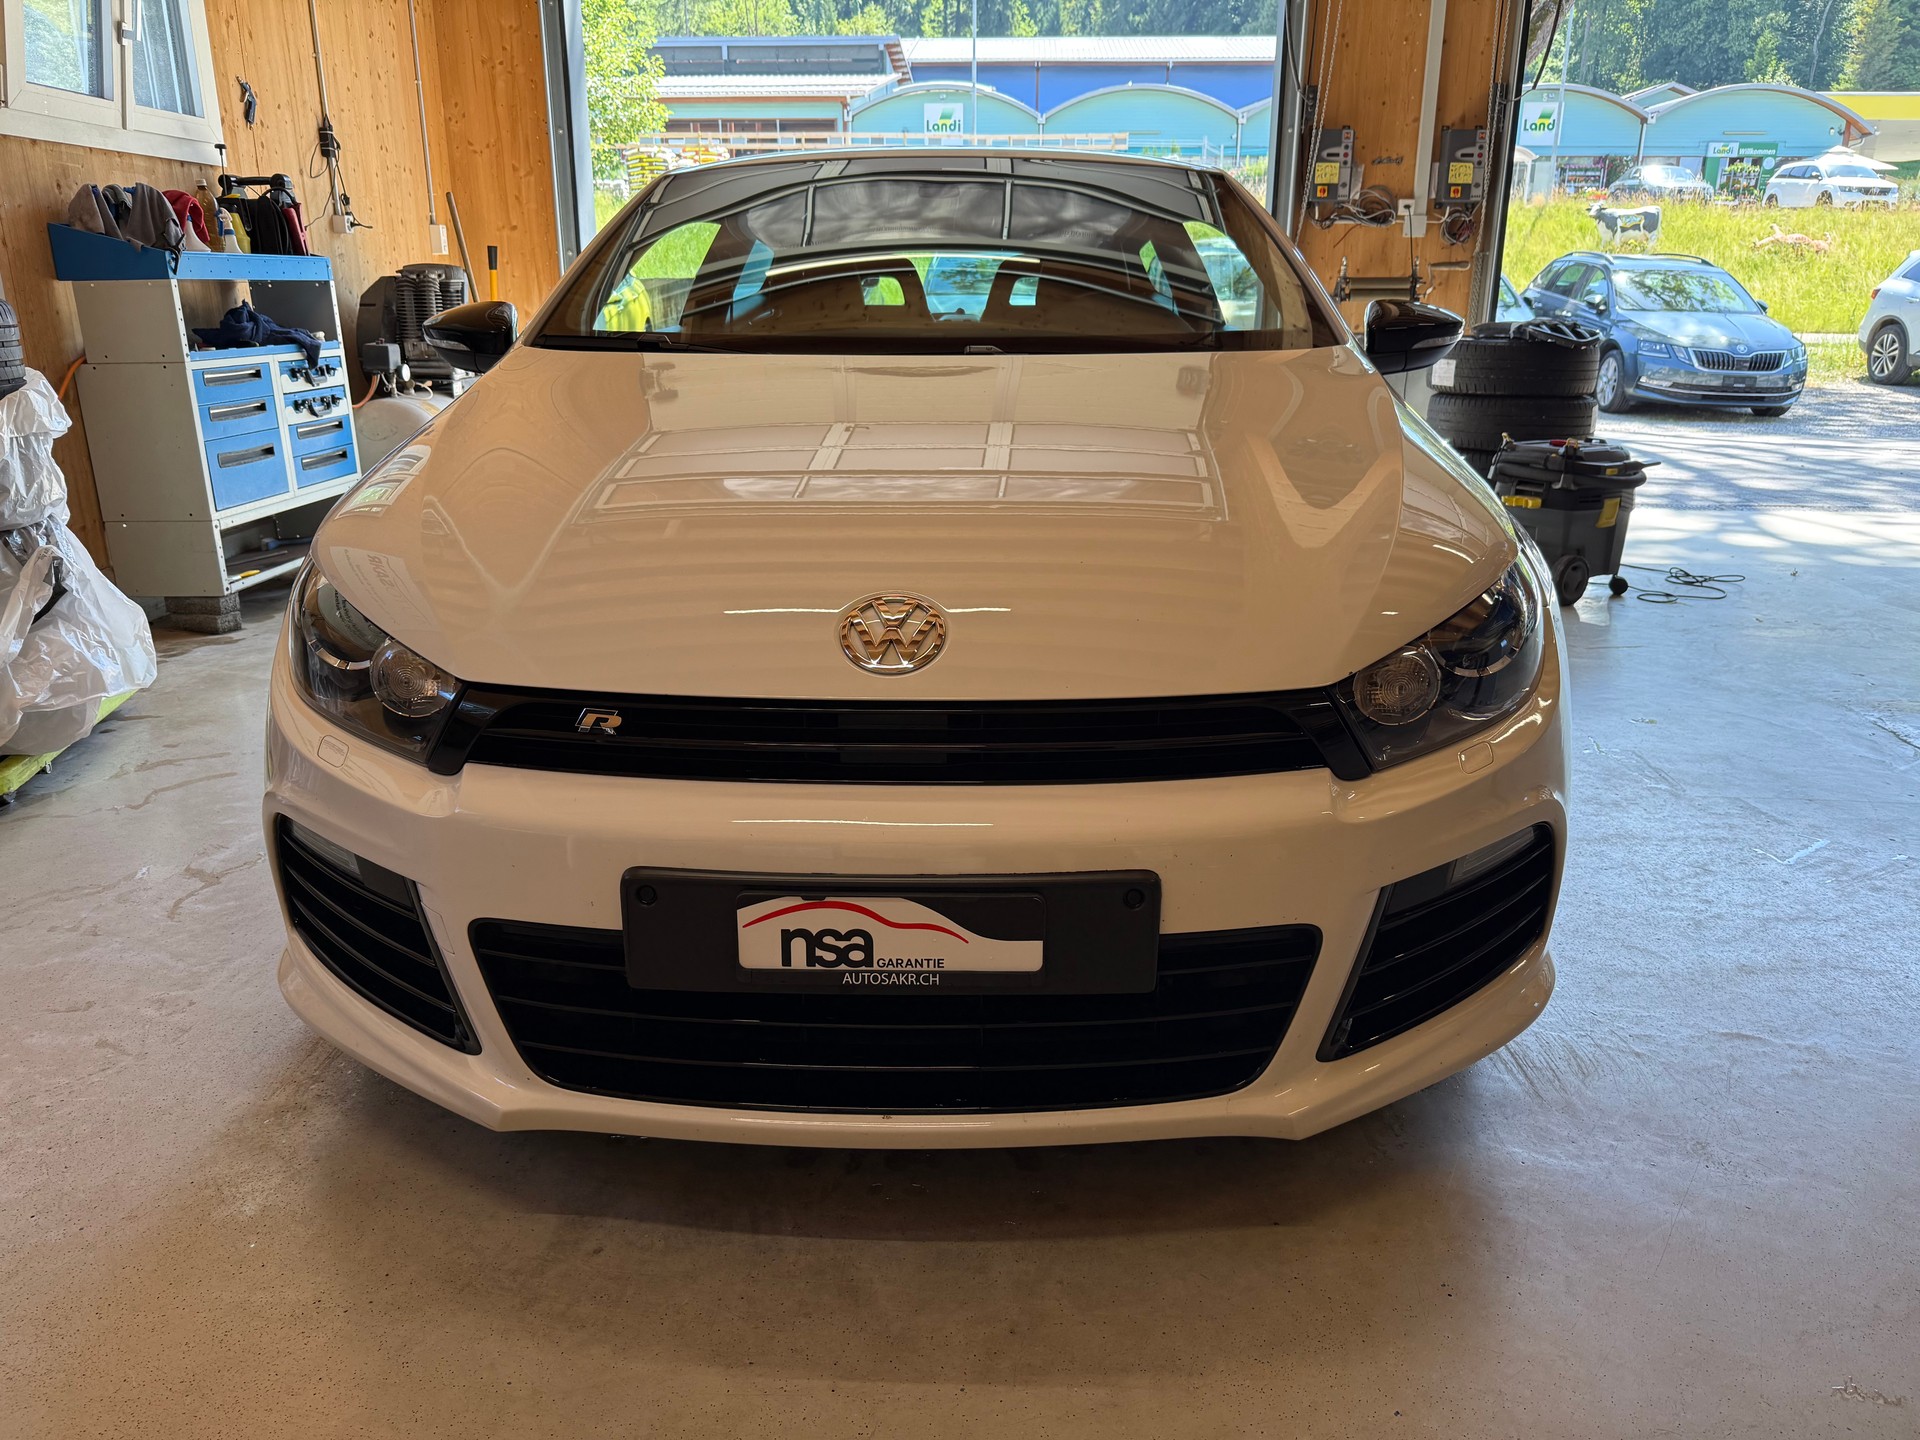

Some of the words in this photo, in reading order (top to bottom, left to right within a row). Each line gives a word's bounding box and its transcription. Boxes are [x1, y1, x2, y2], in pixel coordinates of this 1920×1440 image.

[926, 119, 961, 132] Landi
[1523, 119, 1556, 131] Land
[1713, 146, 1733, 154] Landi
[575, 708, 622, 735] R
[781, 928, 874, 968] nsa
[877, 958, 945, 969] GARANTIE
[842, 972, 940, 986] AUTOSAKR.CH
